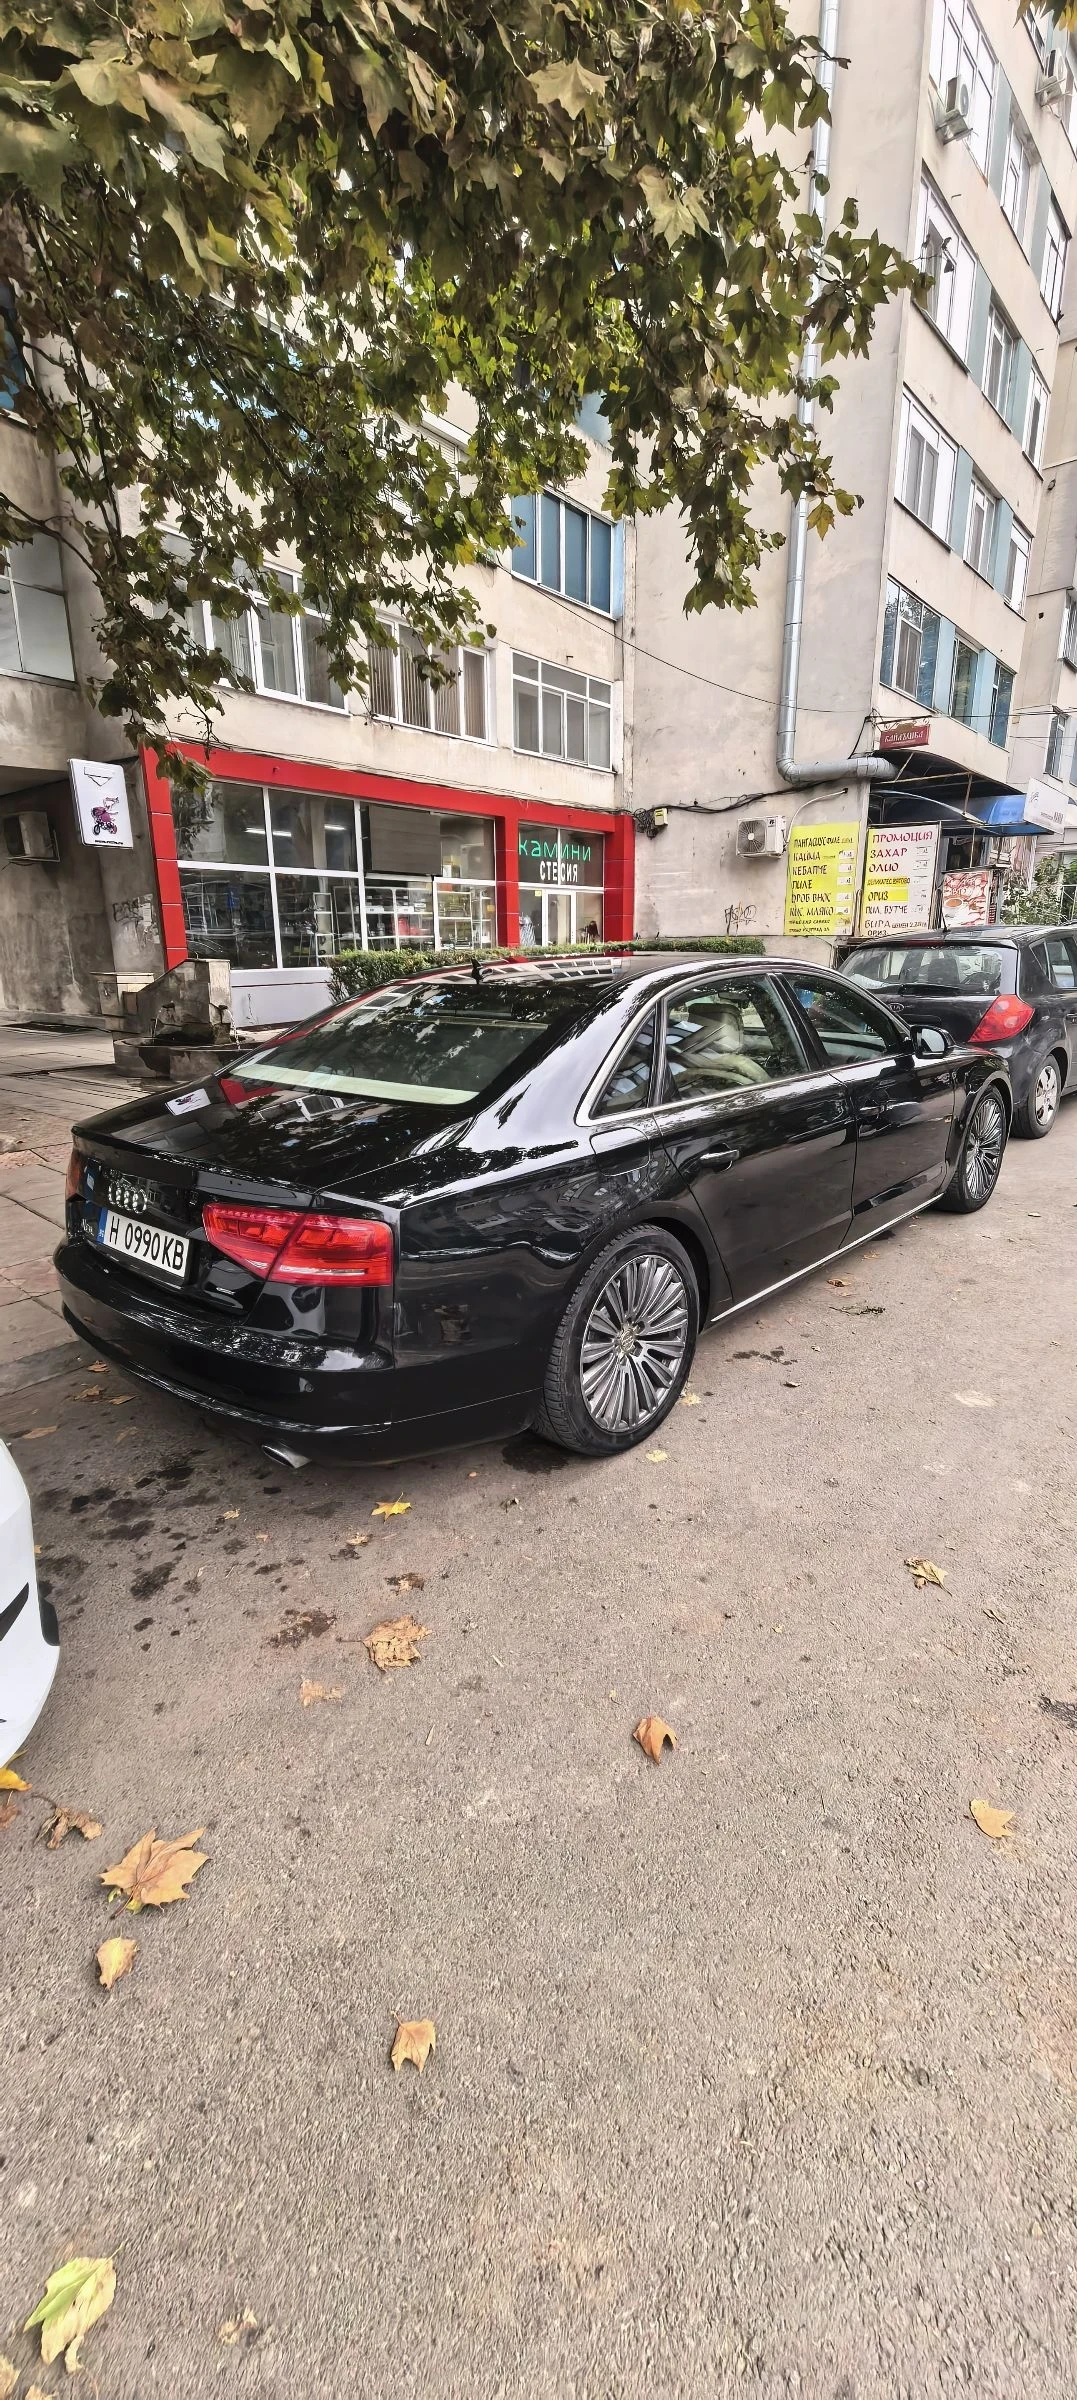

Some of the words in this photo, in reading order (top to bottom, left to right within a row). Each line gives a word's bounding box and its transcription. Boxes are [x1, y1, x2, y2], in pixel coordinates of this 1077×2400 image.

[872, 831, 933, 843] ПРОМОЦИЯ
[793, 851, 820, 861] КАЙМА
[870, 847, 908, 858] ЗАХАР
[792, 865, 827, 875] КЕБАПЧЕ
[869, 862, 899, 872] ОЛИО
[792, 879, 813, 889] ПИЛЕ
[868, 891, 888, 901] ОРИЗ
[884, 905, 908, 914] БУТЧЕ
[864, 920, 891, 929] БИРА
[109, 1215, 120, 1245] H
